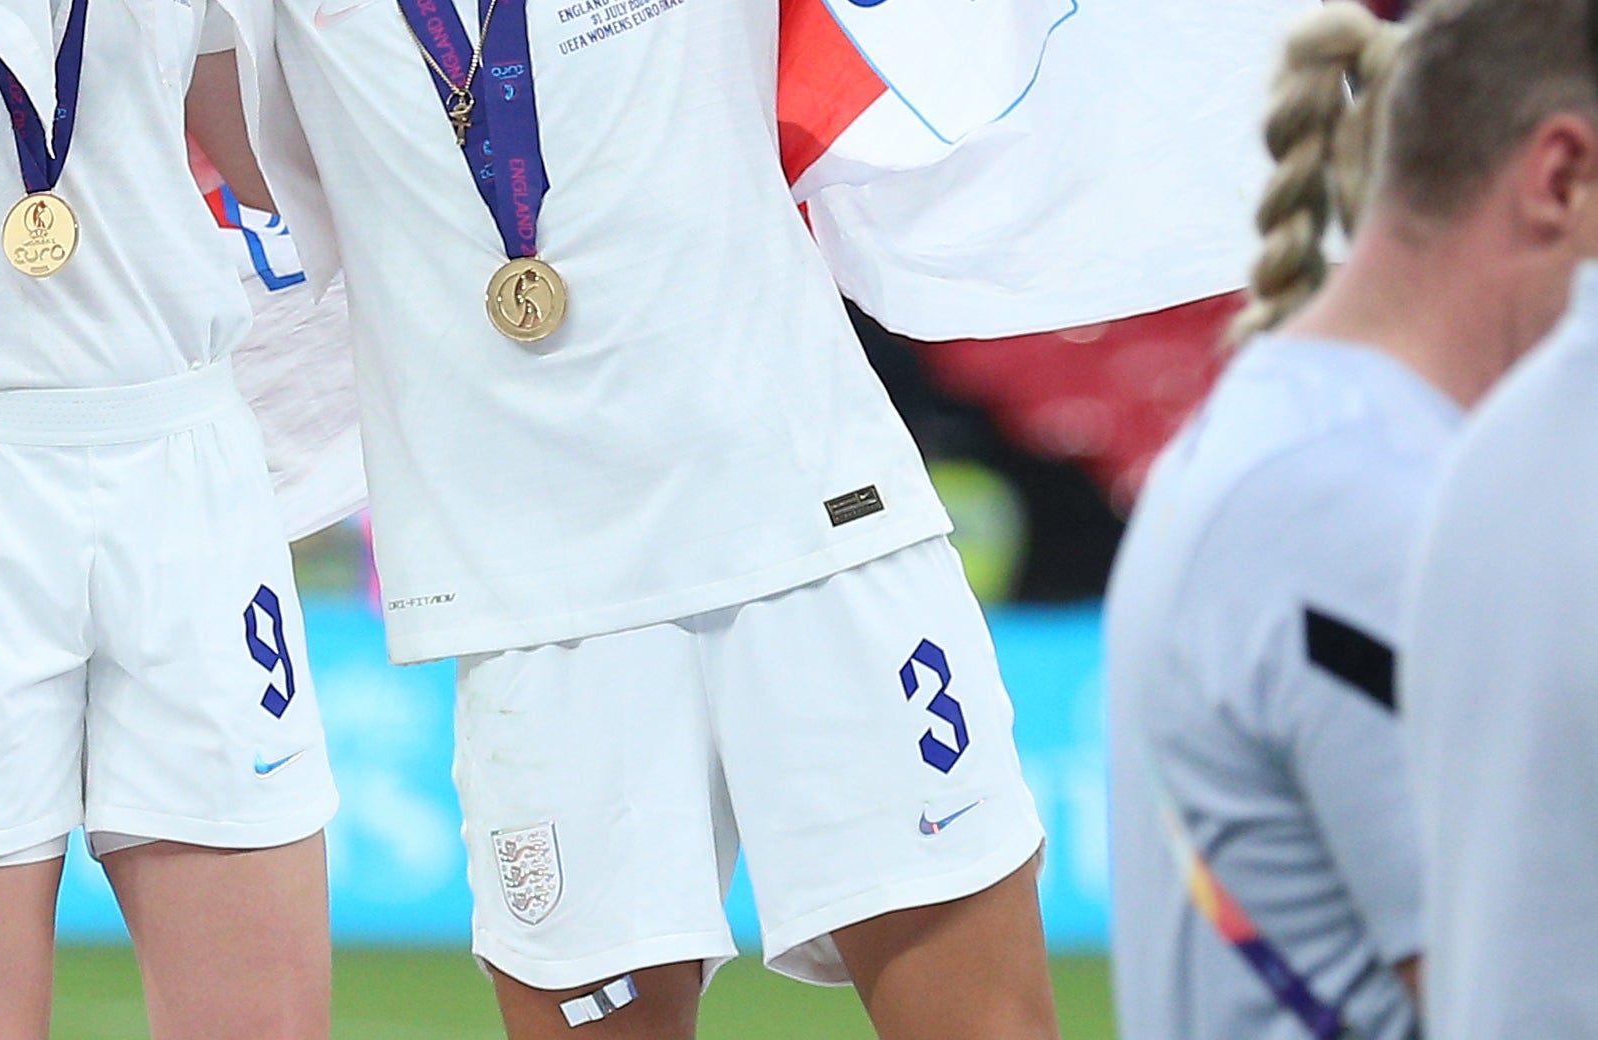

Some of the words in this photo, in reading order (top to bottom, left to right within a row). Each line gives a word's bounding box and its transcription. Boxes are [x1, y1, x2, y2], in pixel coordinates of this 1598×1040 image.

[559, 34, 588, 56] UEFA
[586, 16, 634, 43] WOMENS
[632, 3, 661, 27] EURO
[590, 13, 604, 26] 31
[604, 1, 629, 21] JULY
[509, 158, 536, 241] ENGLAND
[242, 582, 295, 720] 9
[898, 637, 971, 775] 3
